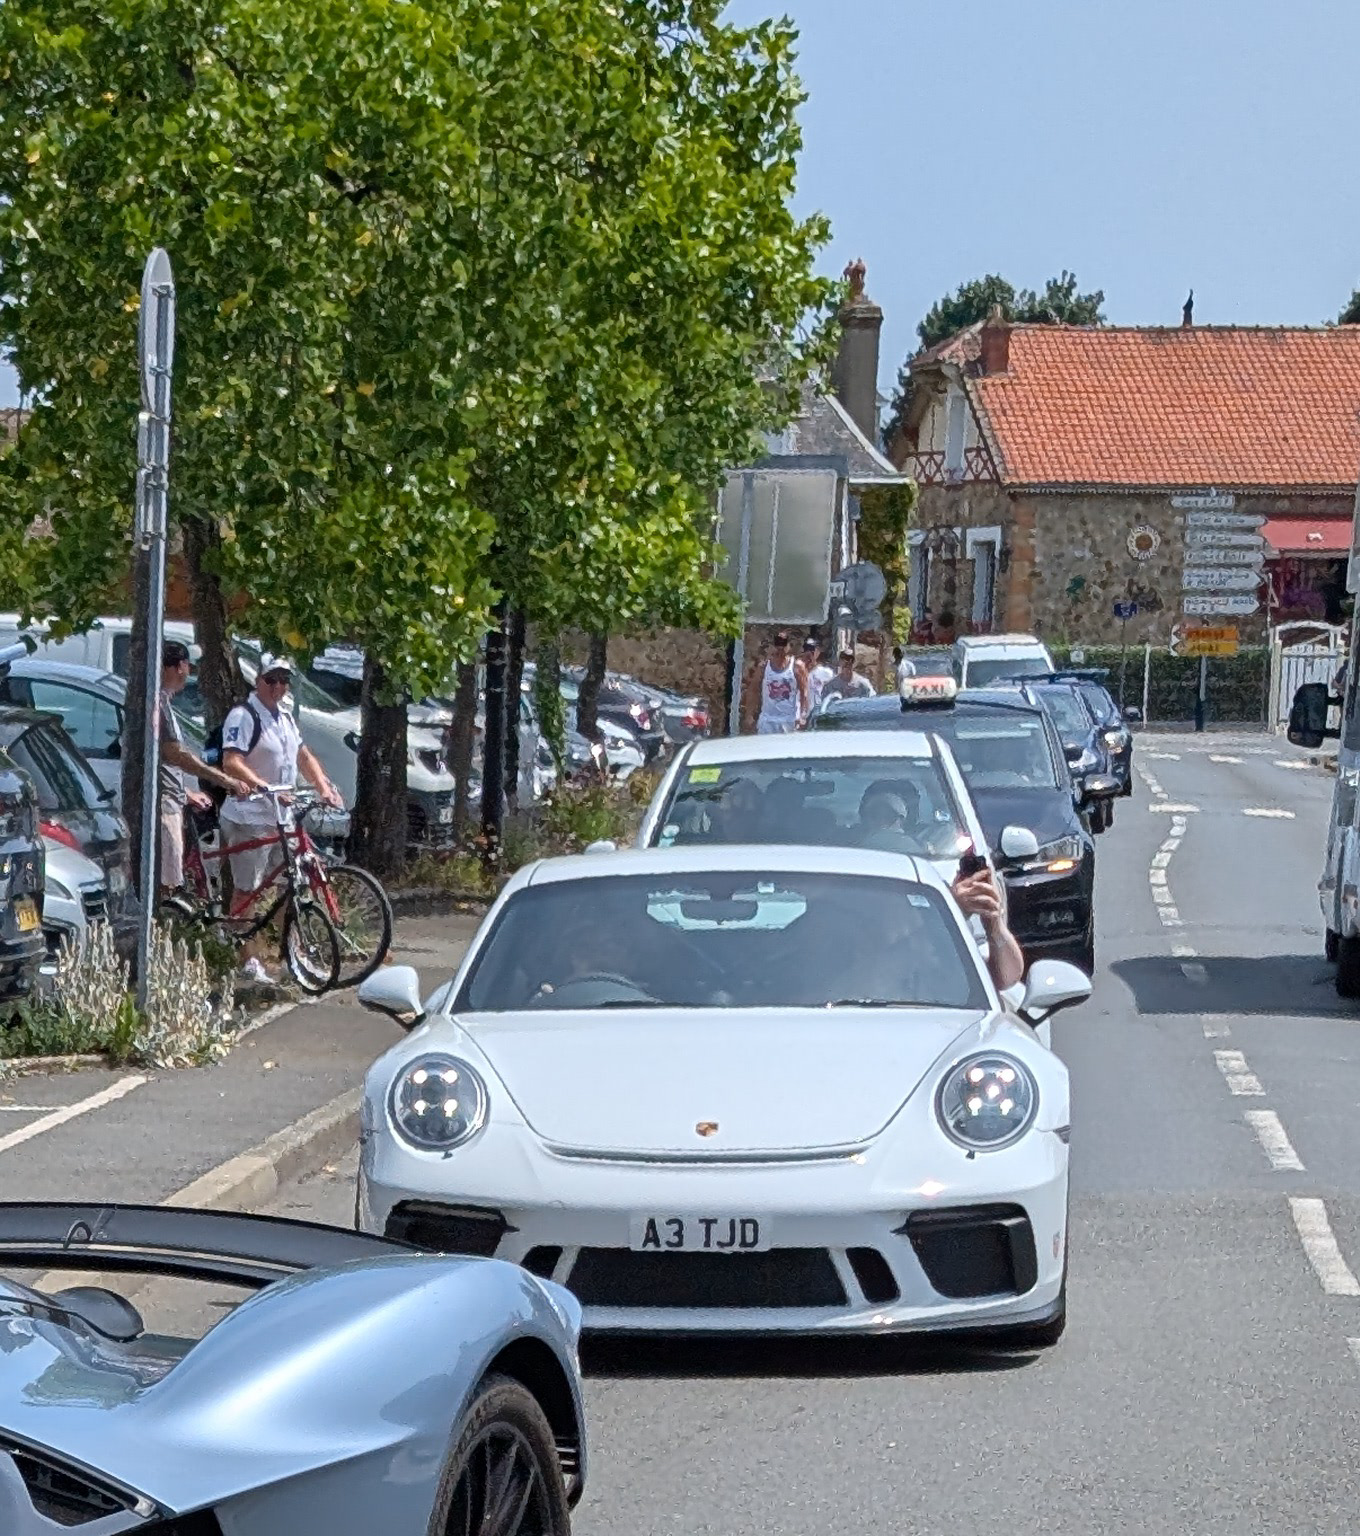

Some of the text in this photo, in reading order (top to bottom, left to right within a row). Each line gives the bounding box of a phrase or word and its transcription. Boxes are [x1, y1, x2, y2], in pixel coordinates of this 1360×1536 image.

[912, 684, 945, 695] TAXI
[642, 1218, 759, 1248] A3 TJD
